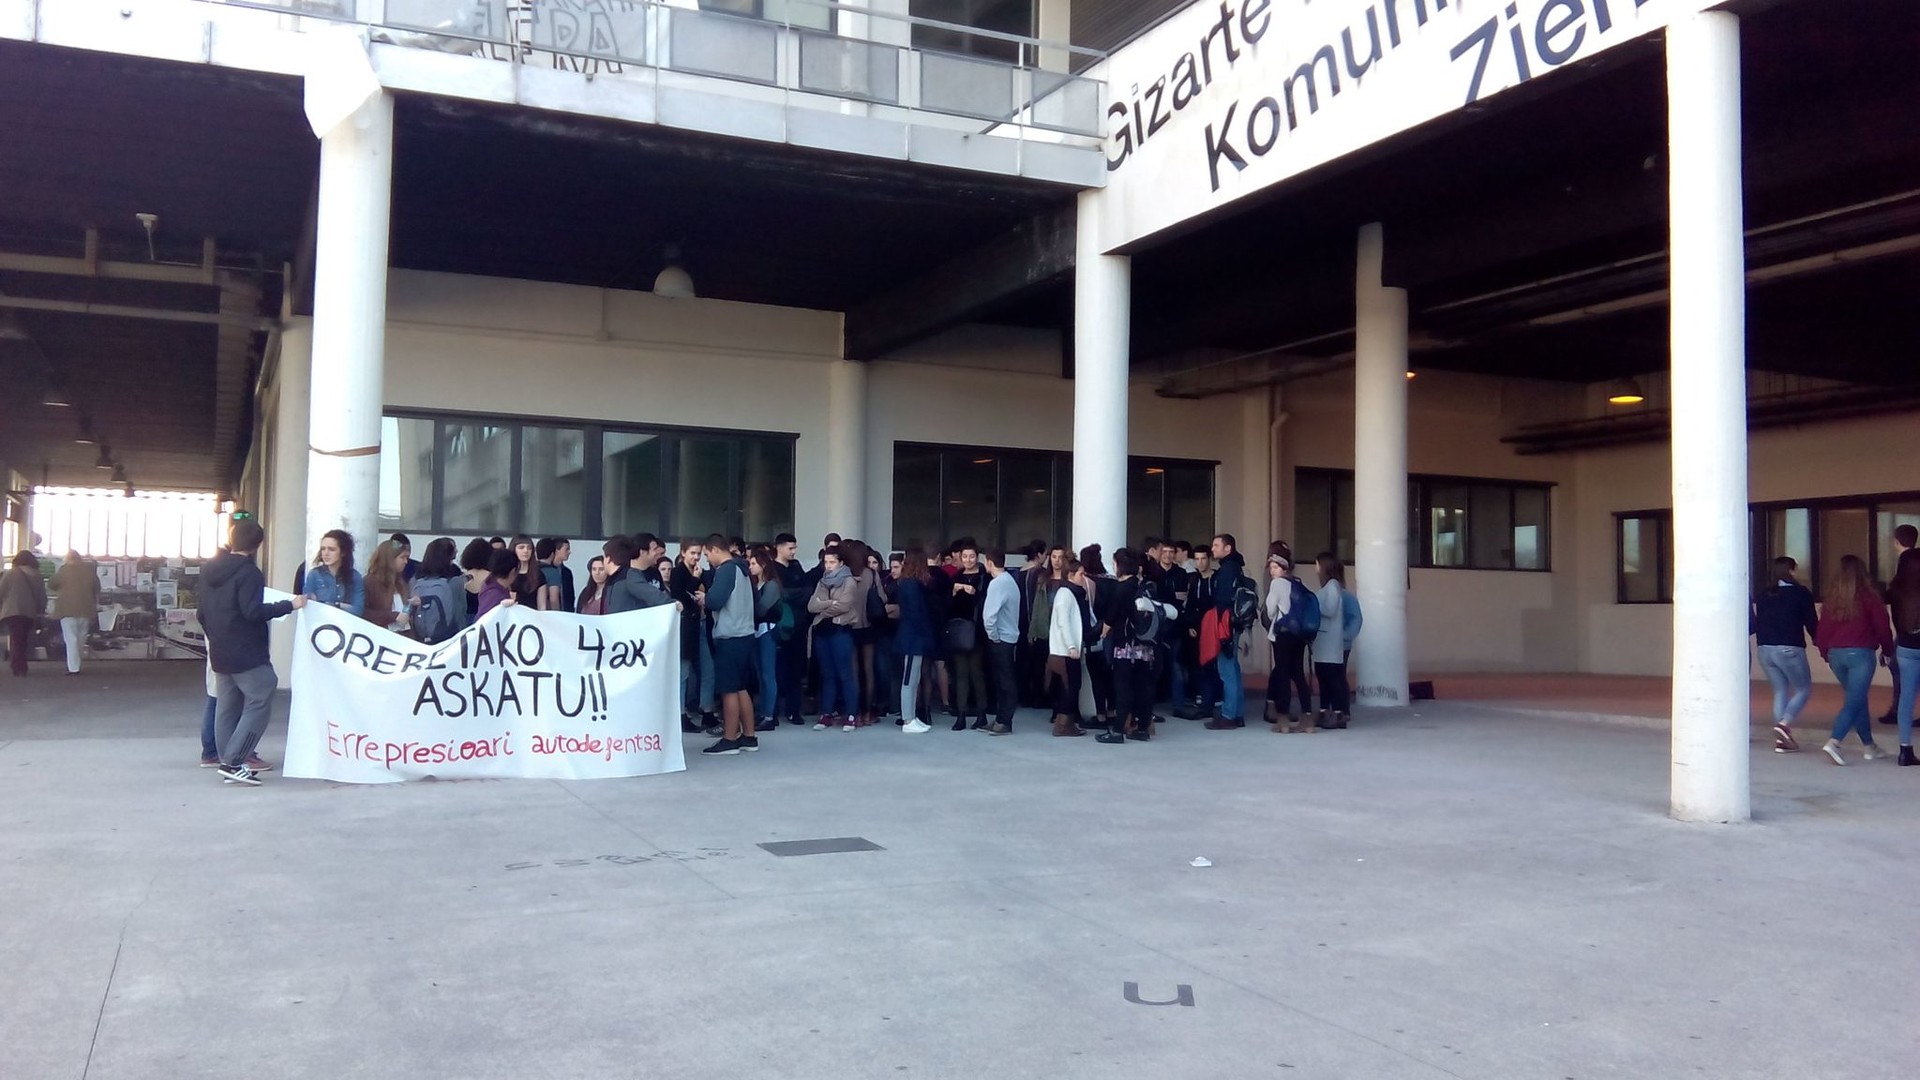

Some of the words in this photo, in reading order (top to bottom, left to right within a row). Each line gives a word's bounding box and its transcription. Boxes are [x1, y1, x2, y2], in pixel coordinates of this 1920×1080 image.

[1106, 0, 1271, 171] Gizarte
[1204, 0, 1449, 194] Komun
[1449, 0, 1651, 105] Zie
[327, 721, 514, 770] Errepresioari
[531, 733, 662, 762] autodefentsa
[413, 669, 607, 722] ASKATU!!
